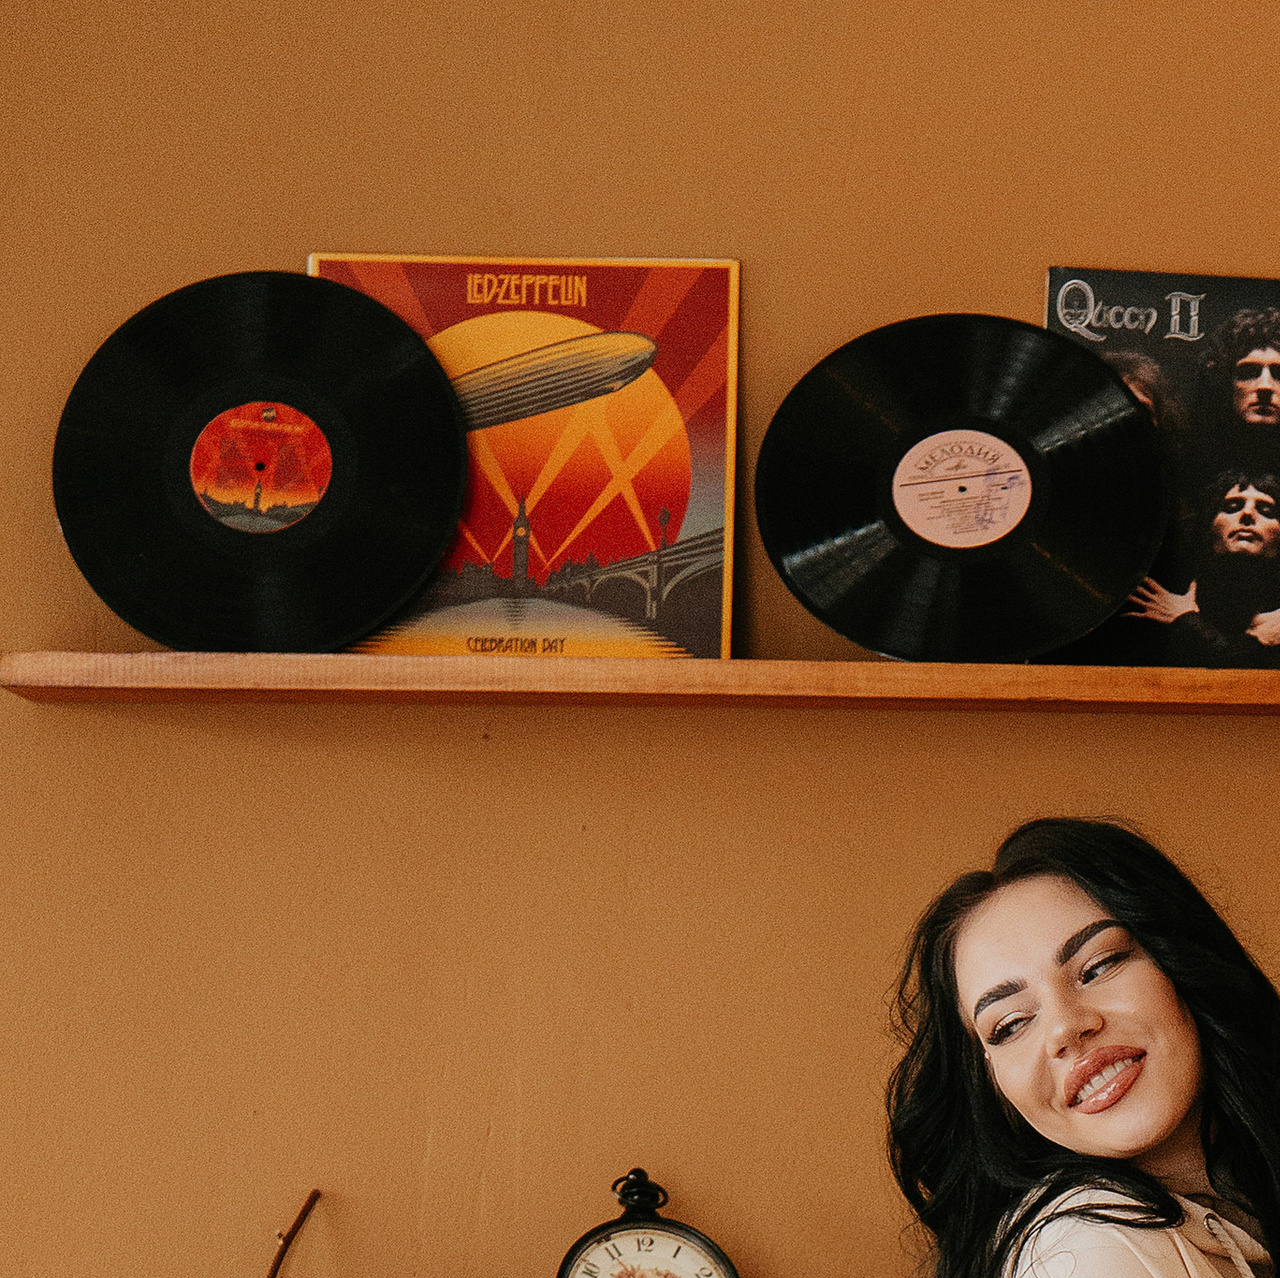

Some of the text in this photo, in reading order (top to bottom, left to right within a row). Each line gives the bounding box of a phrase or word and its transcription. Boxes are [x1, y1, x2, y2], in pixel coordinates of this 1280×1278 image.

[1057, 279, 1207, 342] Queen II
[542, 638, 566, 654] DAY
[604, 1242, 623, 1261] 11
[636, 1237, 654, 1253] 12
[672, 1245, 682, 1259] 1
